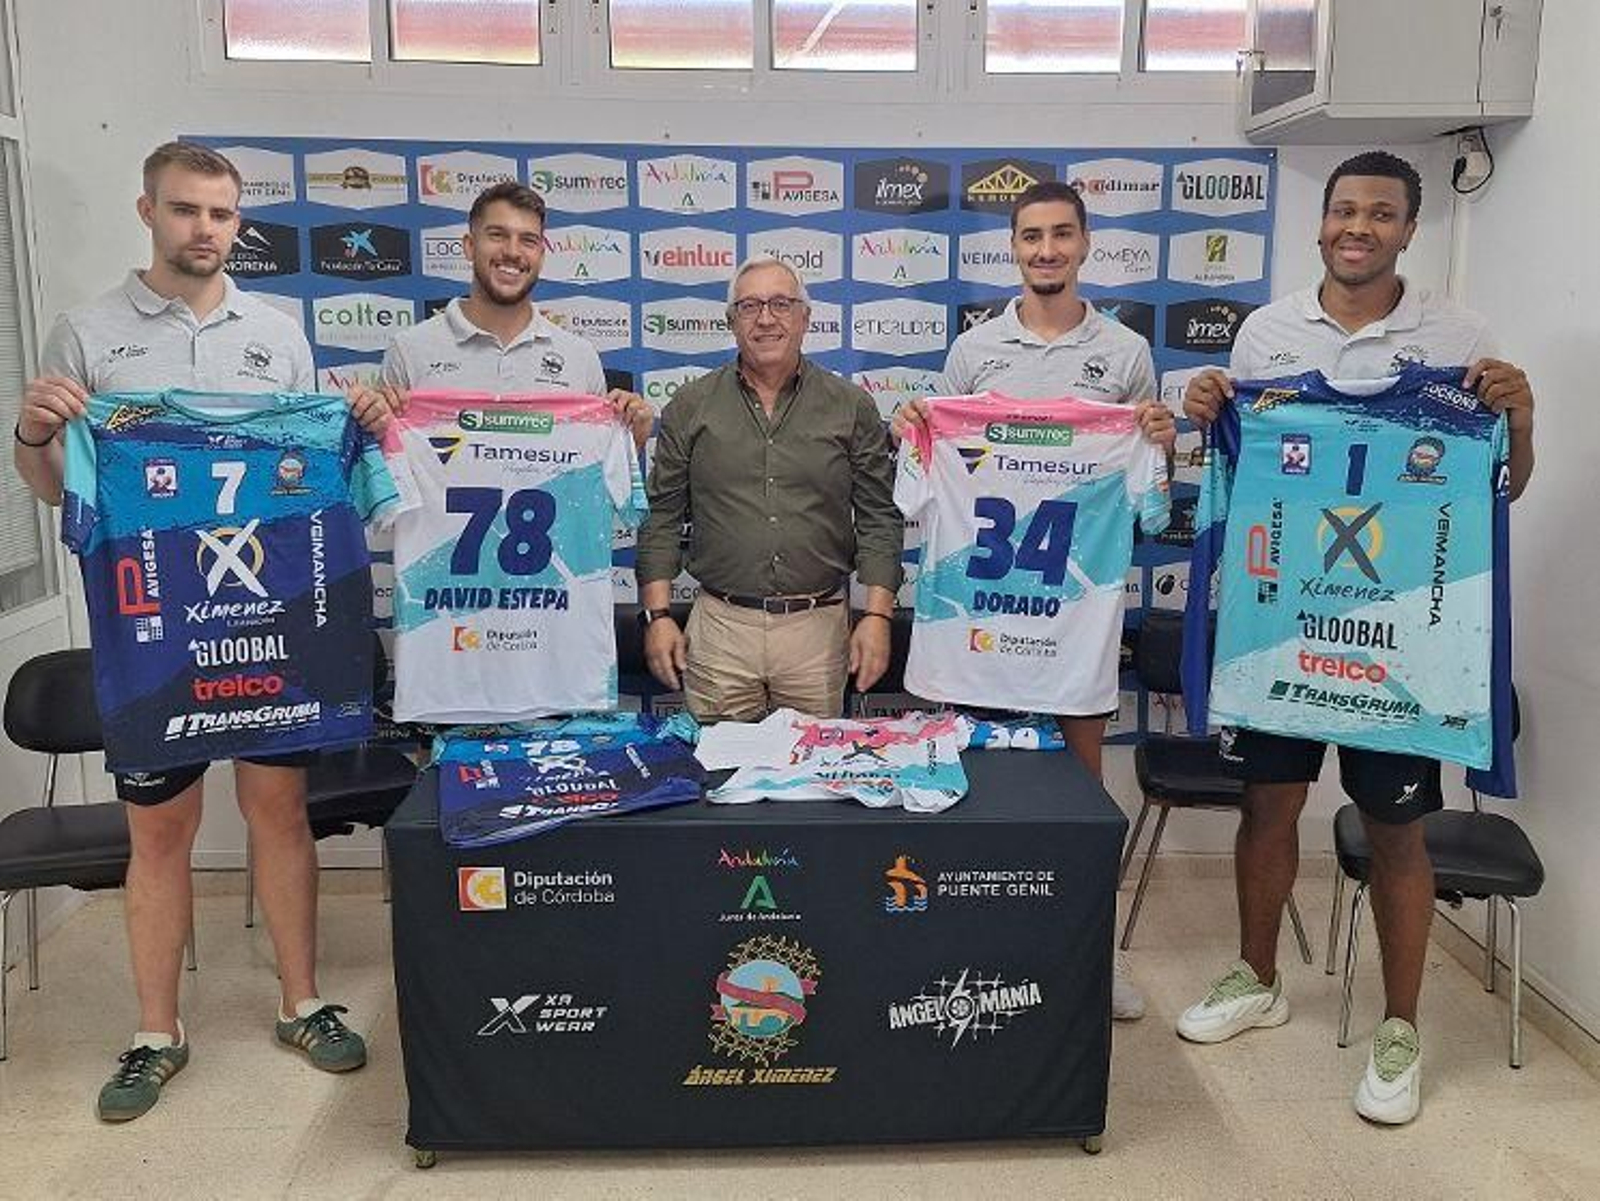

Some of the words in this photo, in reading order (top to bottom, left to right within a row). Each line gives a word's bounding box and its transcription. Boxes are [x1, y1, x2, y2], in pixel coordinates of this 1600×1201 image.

[1182, 174, 1265, 200] GLOOBAL
[319, 302, 412, 326] colten
[469, 443, 578, 464] Tamesur
[994, 454, 1097, 476] Tamesur
[1346, 444, 1368, 496] 1
[211, 461, 247, 515] 7
[446, 487, 557, 577] 78
[965, 497, 1078, 586] 34
[310, 509, 329, 628] VEIMANCHA
[1427, 502, 1452, 626] VEIMANCHA
[424, 587, 494, 611] DAVID
[499, 587, 569, 611] ESTEPA
[972, 590, 1061, 617] DORADO
[1303, 613, 1398, 650] GLOOBAL
[196, 635, 290, 667] GLOOBAL
[717, 848, 799, 868] Andalucía
[513, 871, 613, 890] Diputación
[937, 871, 1030, 882] AYUNTAMIENTO
[1035, 870, 1055, 882] DE
[513, 891, 536, 905] de
[542, 886, 615, 905] Córdoba
[937, 883, 1001, 897] PUENTE
[1006, 882, 1054, 897] GENIL
[539, 1006, 608, 1019] SPORT
[888, 999, 945, 1030] ÁNGEL
[979, 980, 1043, 1014] MANÍA
[535, 1021, 596, 1033] WEAR
[682, 1065, 745, 1086] ÁNGEL
[749, 1066, 838, 1084] XIMENEZ
